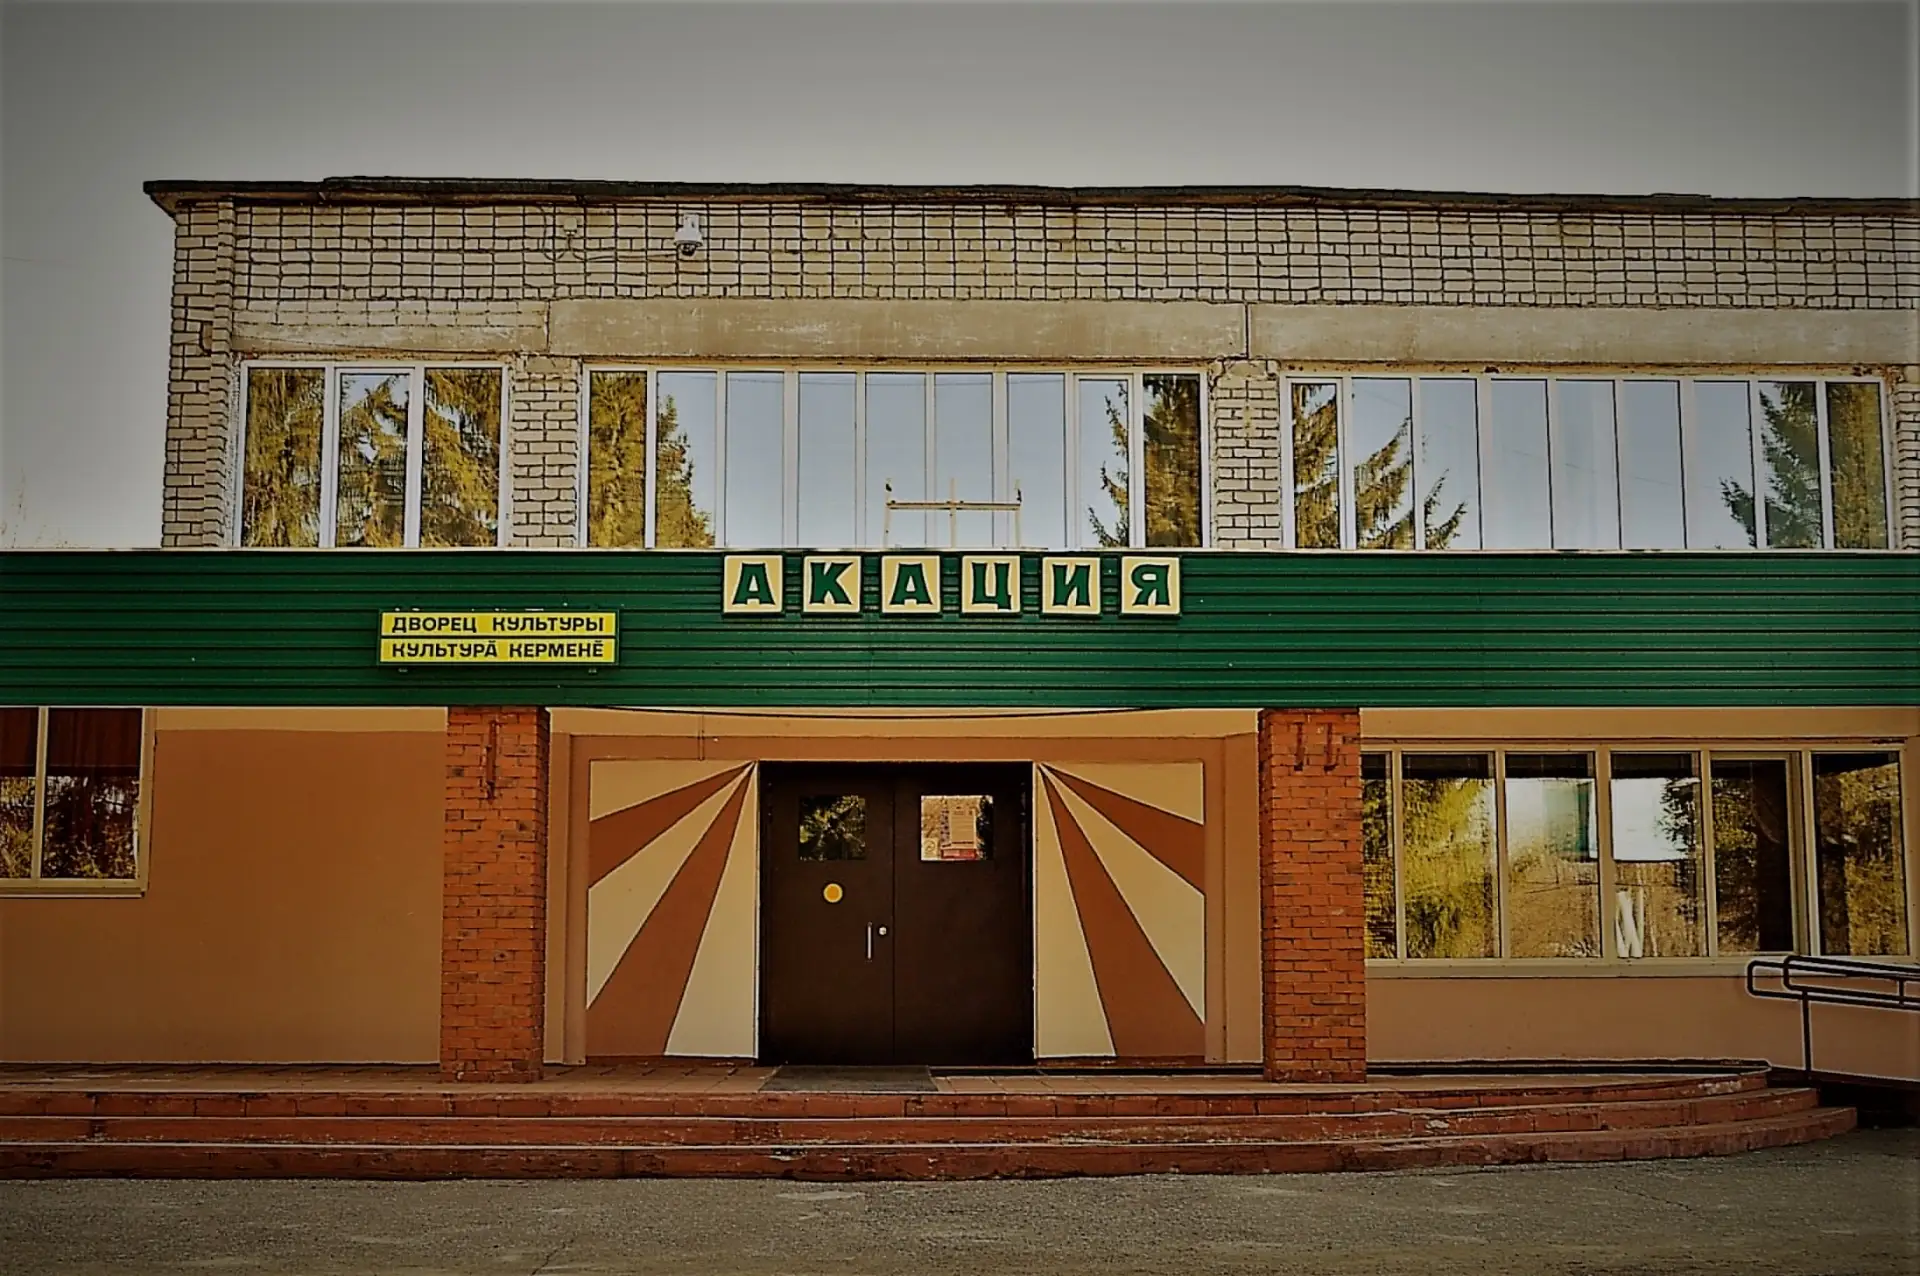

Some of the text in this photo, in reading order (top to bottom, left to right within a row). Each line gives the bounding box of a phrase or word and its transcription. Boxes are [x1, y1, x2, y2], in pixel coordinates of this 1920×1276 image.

[731, 562, 1171, 610] АКАЦИЯ
[392, 617, 604, 633] ДВОРЕЦ КУЛЬТУРЫ
